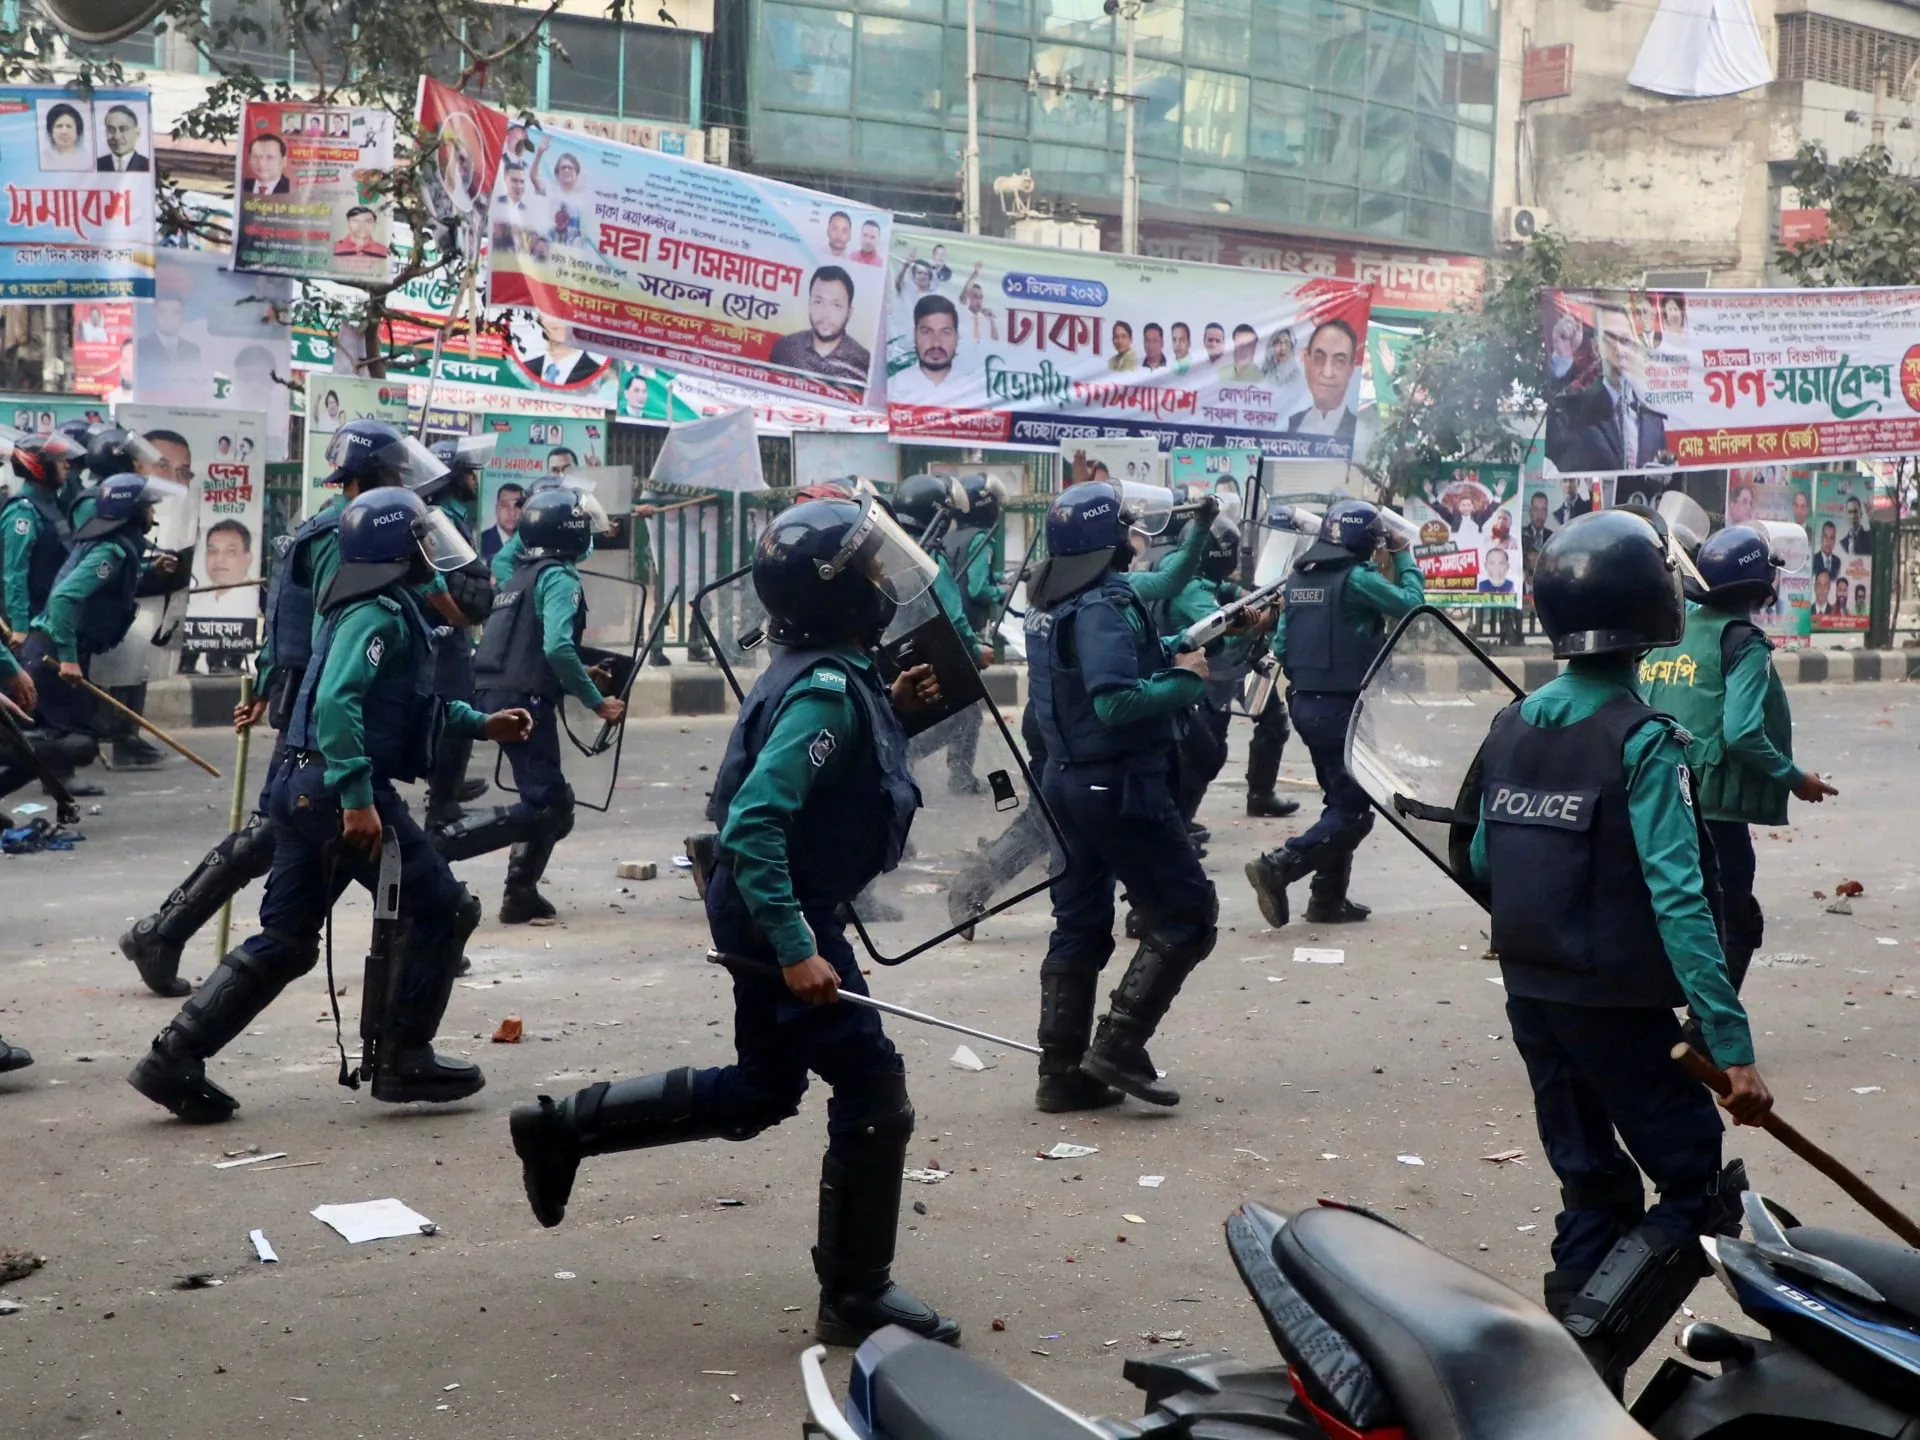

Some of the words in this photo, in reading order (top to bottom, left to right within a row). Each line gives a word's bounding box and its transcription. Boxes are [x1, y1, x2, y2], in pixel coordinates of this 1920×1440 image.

[6, 184, 131, 240] সমাবেশ
[596, 203, 619, 222] ঢাকা
[599, 223, 651, 263] মহা
[657, 236, 803, 296] গণসমাবেশ
[1351, 249, 1481, 295] লিমিটেড
[637, 272, 714, 308] সফল
[722, 292, 781, 320] হোক
[1007, 278, 1022, 292] ১০
[1026, 276, 1068, 298] ডিসেম্বর
[1071, 286, 1104, 301] ২০২২
[1005, 307, 1104, 355] ঢাকা
[1752, 351, 1782, 365] ঢাকা
[1787, 347, 1838, 364] বিভাগীয়
[985, 354, 1073, 409] বিভাগীয়
[1073, 381, 1198, 419] গণসমাবেশ
[1202, 406, 1238, 424] সফল
[1242, 408, 1279, 427] করুন
[347, 433, 373, 448] POLICE
[1707, 430, 1752, 456] মনিরুল
[1756, 432, 1778, 451] হক
[207, 463, 250, 486] দেশ
[111, 489, 133, 500] POLICE
[204, 484, 253, 505] মানুষ
[373, 511, 404, 527] POLICE
[1082, 503, 1111, 521] POLICE
[1341, 516, 1363, 525] POLICE
[1209, 549, 1232, 558] POLICE
[1738, 549, 1762, 567] POLICE
[1293, 591, 1320, 601] POLICE
[198, 621, 243, 638] আহমদ
[1491, 788, 1583, 822] POLICE
[1774, 1284, 1827, 1312] 150
